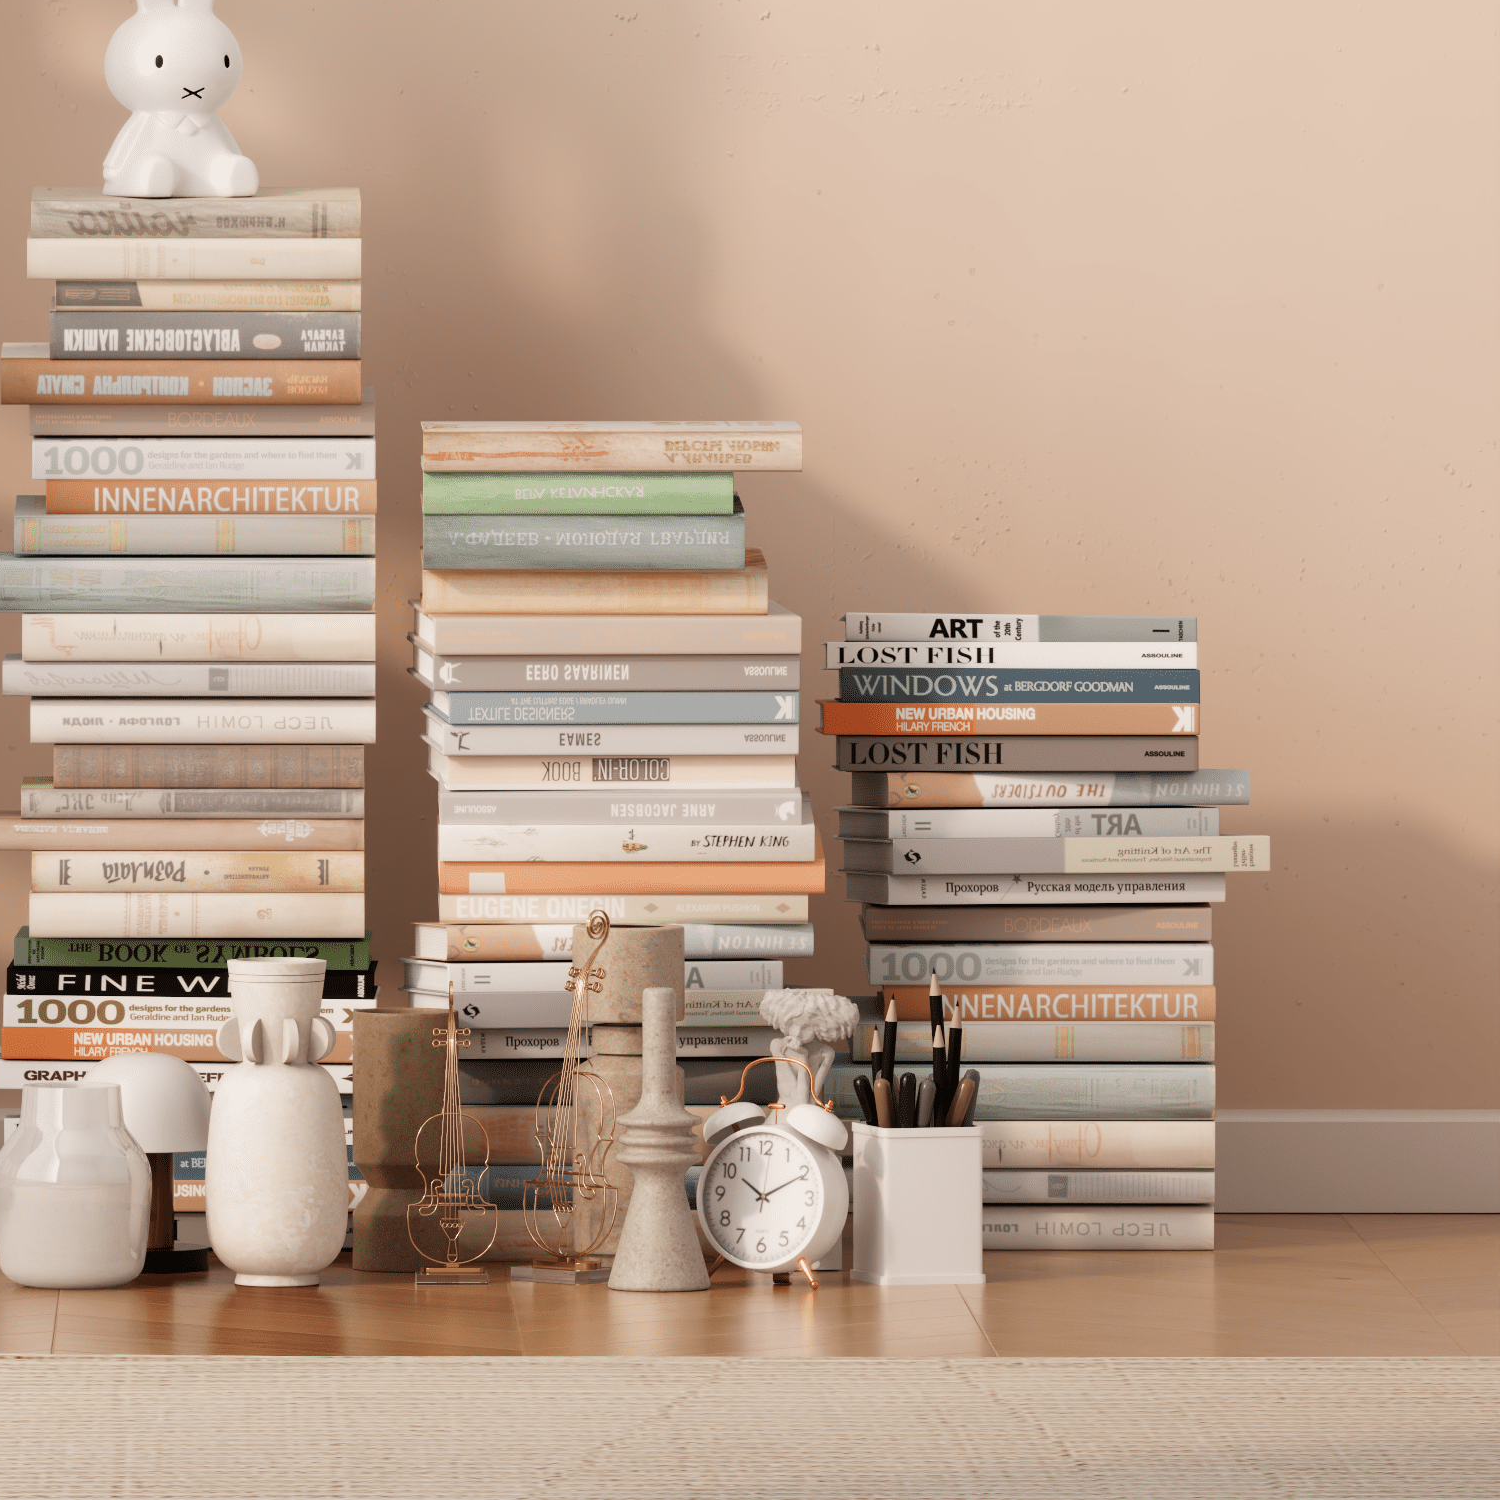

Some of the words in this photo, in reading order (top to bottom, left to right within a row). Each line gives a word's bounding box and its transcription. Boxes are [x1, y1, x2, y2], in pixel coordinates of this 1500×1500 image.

[167, 412, 257, 428] BORDEAUX
[319, 416, 362, 424] ASSOULINE
[42, 446, 144, 476] 1000
[147, 451, 179, 462] designs
[181, 451, 194, 460] for
[195, 451, 207, 460] the
[209, 451, 241, 462] gardens
[243, 451, 259, 460] and
[260, 451, 286, 460] where
[288, 452, 296, 460] to
[298, 451, 315, 460] find
[316, 451, 337, 460] them
[148, 461, 184, 470] Geraldine
[185, 461, 203, 470] and
[205, 461, 220, 470] Ian
[222, 461, 245, 472] Rudge
[94, 487, 360, 512] INNENARCHITEKTUR
[929, 618, 983, 639] ART
[1014, 617, 1023, 641] Century
[836, 646, 918, 664] LOST
[926, 646, 997, 665] FISH
[852, 674, 999, 697] WINDOWS
[1003, 682, 1013, 692] at
[1014, 680, 1073, 693] BERGDORF
[1074, 680, 1134, 693] GOODMAN
[896, 707, 927, 720] NEW
[928, 707, 974, 721] URBAN
[976, 707, 1036, 721] HOUSING
[896, 721, 929, 732] HILARY
[931, 721, 971, 732] FRENCH
[848, 743, 928, 765] LOST
[936, 743, 1004, 765] FISH
[541, 762, 581, 781] BOOK
[991, 784, 1067, 799] OUTSIDERS
[1076, 783, 1106, 798] THE
[1155, 782, 1220, 799] HINTON
[454, 805, 496, 813] ASSOULINE
[611, 803, 677, 817] JACOBSEN
[682, 803, 715, 817] ARNE
[702, 835, 755, 848] STEPHEN
[760, 835, 790, 848] KING
[945, 882, 999, 897] Прохоров
[1027, 881, 1071, 896] Русская
[1073, 883, 1115, 896] модель
[1116, 882, 1186, 896] управления
[456, 897, 540, 919] EUGENE
[547, 897, 625, 919] ONEGIN
[676, 903, 720, 913] ALEXANDR
[722, 903, 760, 913] PUSHKIN
[1004, 917, 1093, 933] BORDEAUX
[1155, 921, 1198, 929] ASSOULINE
[718, 935, 783, 951] HINTON
[881, 952, 982, 982] 1000
[985, 957, 1017, 968] designs
[1019, 957, 1032, 966] for
[1033, 957, 1046, 966] the
[1047, 957, 1080, 968] gardens
[1081, 957, 1097, 966] and
[1098, 957, 1124, 966] where
[1125, 958, 1134, 966] to
[1135, 957, 1153, 966] find
[1154, 957, 1175, 966] them
[986, 967, 1026, 976] Geraldine
[1027, 967, 1041, 976] and
[1043, 967, 1055, 976] Ian
[1057, 967, 1082, 977] Rudge
[58, 974, 156, 992] FINE
[16, 999, 126, 1025] 1000
[129, 1004, 163, 1015] designs
[165, 1004, 180, 1013] for
[182, 1004, 196, 1013] the
[197, 1004, 231, 1015] gardens
[129, 1013, 167, 1022] Geraldine
[168, 1013, 188, 1022] and
[190, 1013, 205, 1022] Ian
[73, 1033, 104, 1045] NEW
[105, 1033, 152, 1046] URBAN
[154, 1033, 214, 1047] HOUSING
[505, 1035, 560, 1050] Прохоров
[678, 1036, 750, 1049] управления
[73, 1047, 108, 1057] HILARY
[740, 1147, 751, 1162] 11
[758, 1140, 774, 1156] 12
[785, 1148, 790, 1163] 1
[722, 1163, 737, 1179] 10
[799, 1165, 810, 1181] 2
[715, 1186, 726, 1202] 9
[804, 1191, 815, 1207] 3
[719, 1210, 731, 1226] 8
[795, 1215, 807, 1231] 4
[735, 1228, 746, 1244] 7
[778, 1231, 789, 1247] 5
[755, 1237, 767, 1253] 6
